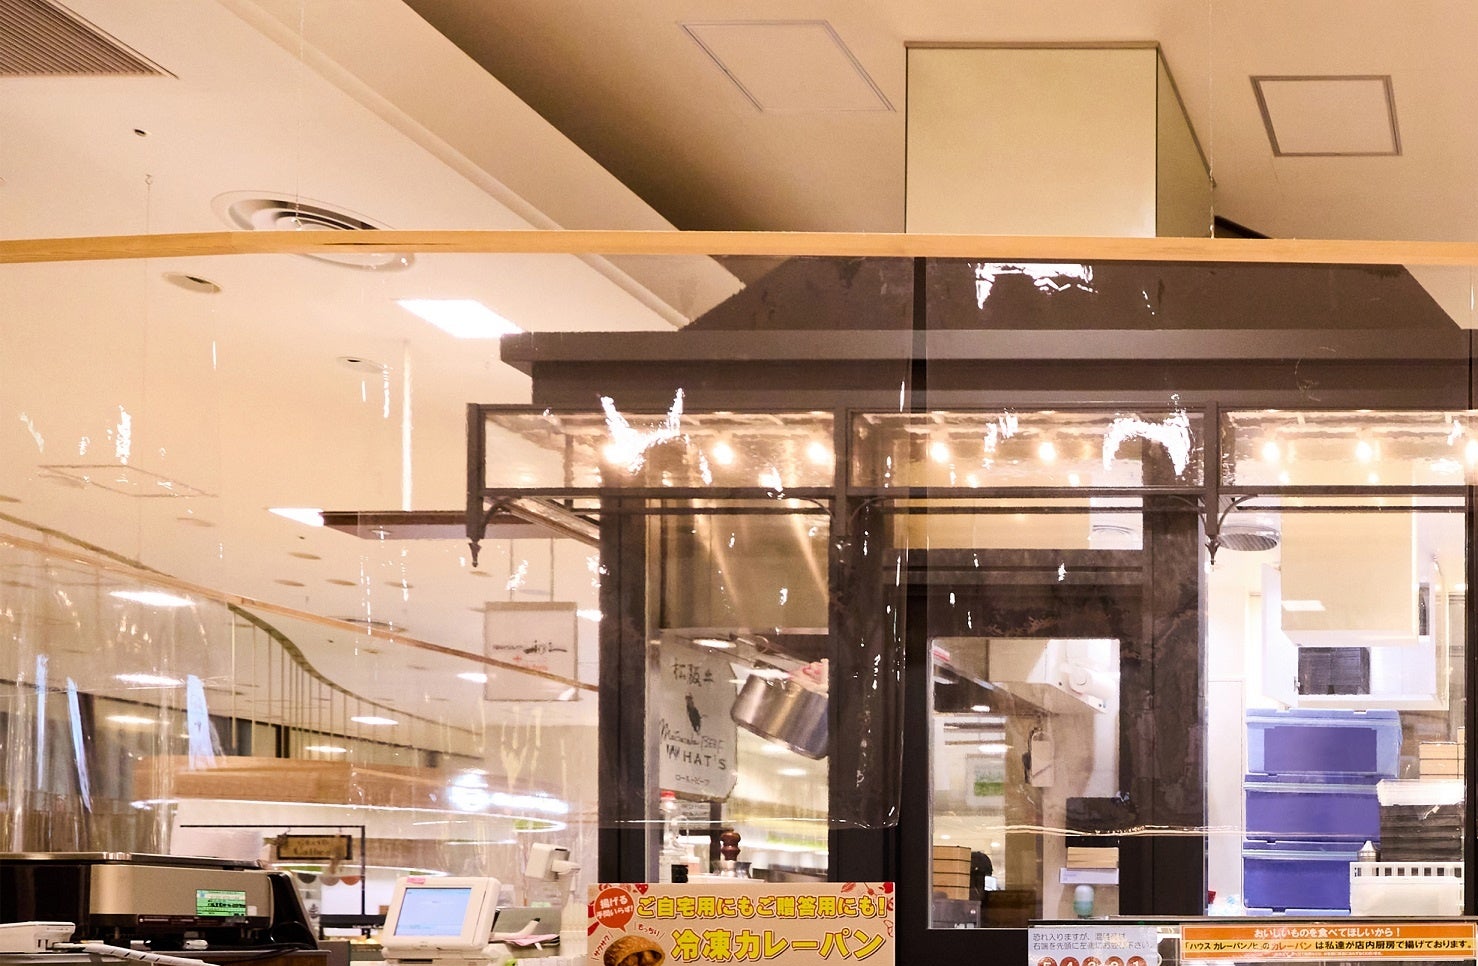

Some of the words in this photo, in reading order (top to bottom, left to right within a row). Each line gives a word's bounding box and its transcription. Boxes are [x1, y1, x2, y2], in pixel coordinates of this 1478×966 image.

[637, 895, 887, 919] ご自宅用にもご贈答用にも！
[1254, 928, 1401, 938] おいしいものを食べてほしいから！
[670, 928, 885, 962] 冷凍カレーパン
[1184, 941, 1211, 950] 「ハウス
